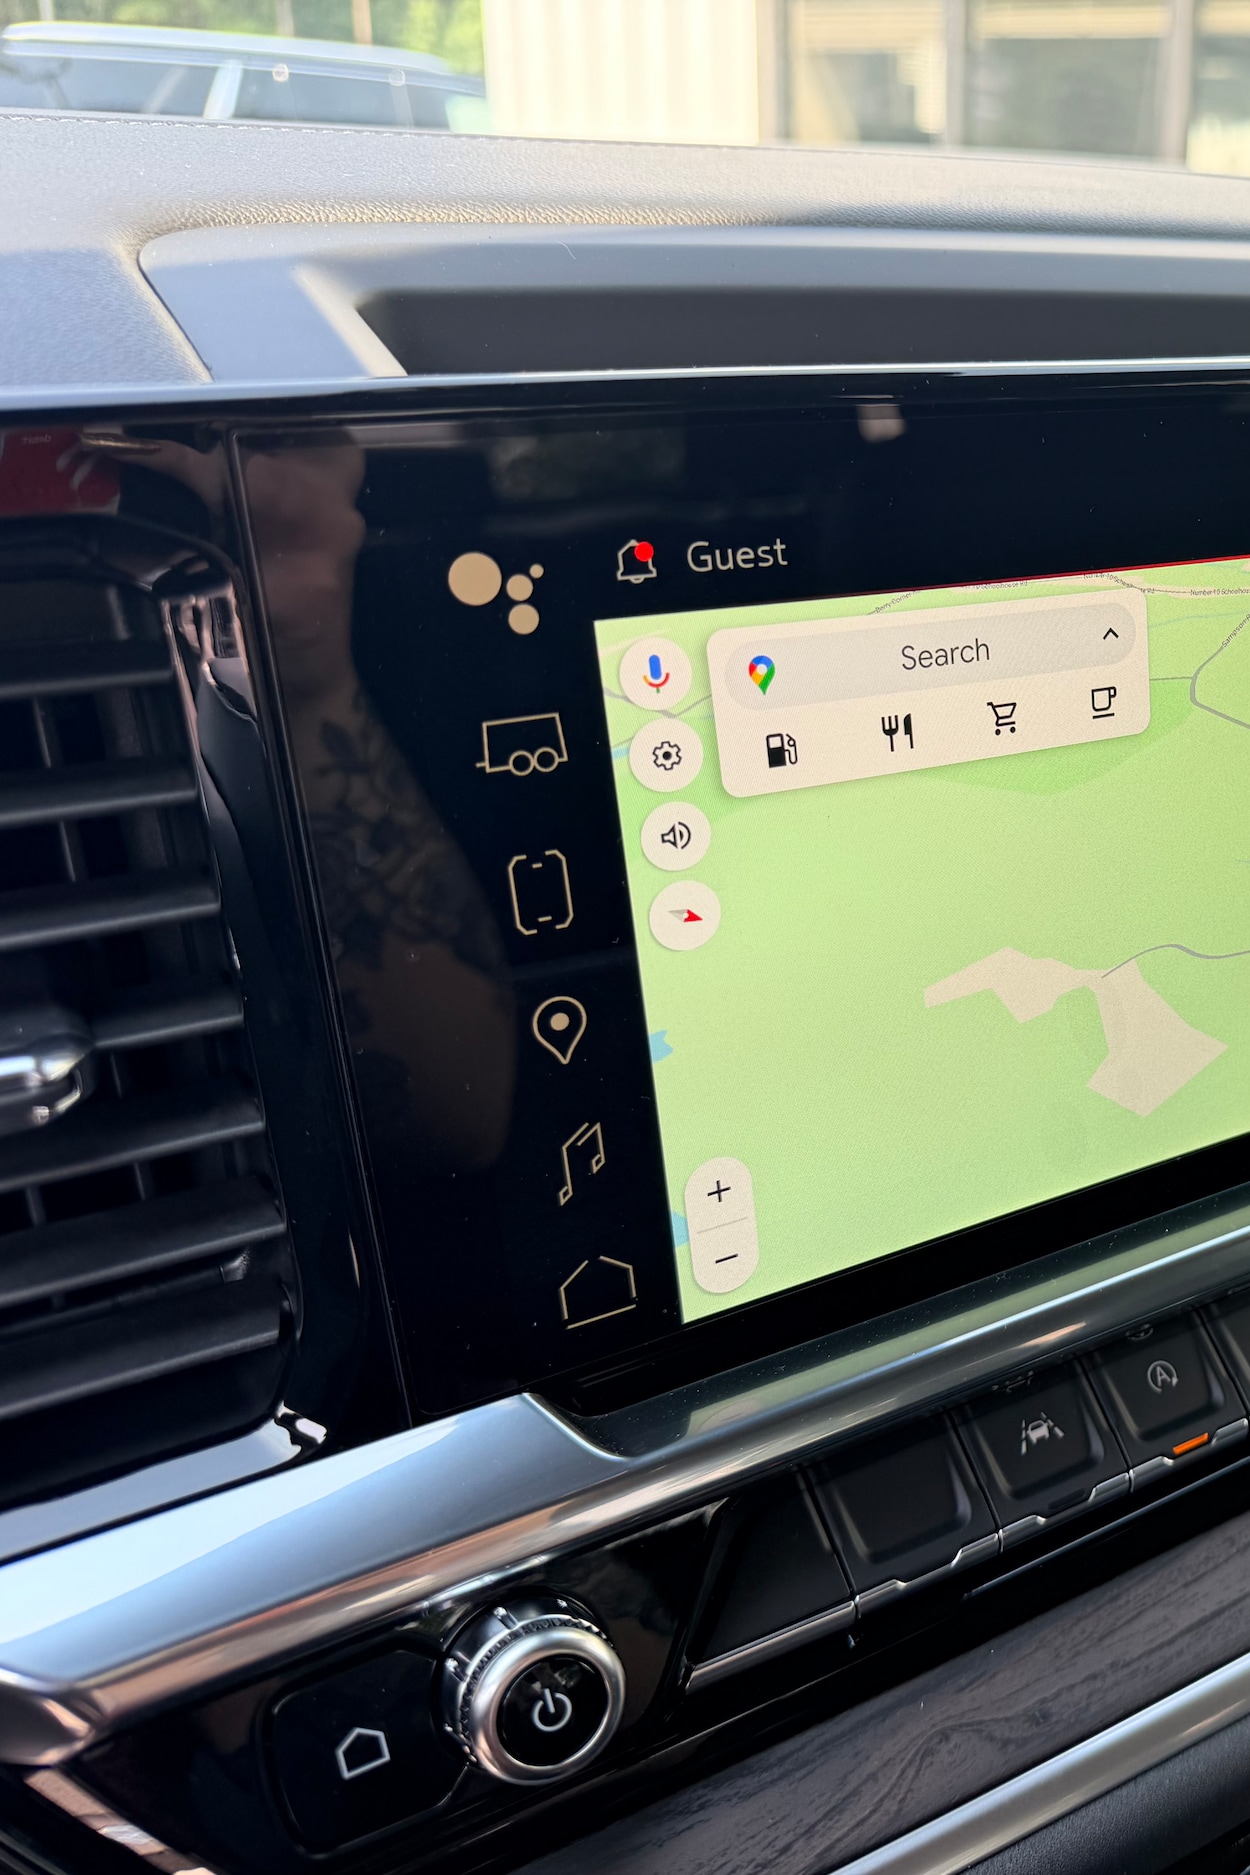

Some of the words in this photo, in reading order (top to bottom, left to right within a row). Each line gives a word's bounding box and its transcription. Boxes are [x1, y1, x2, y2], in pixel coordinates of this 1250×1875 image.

[686, 538, 788, 573] Guest
[1221, 620, 1247, 648] Sampson
[901, 638, 990, 671] Search
